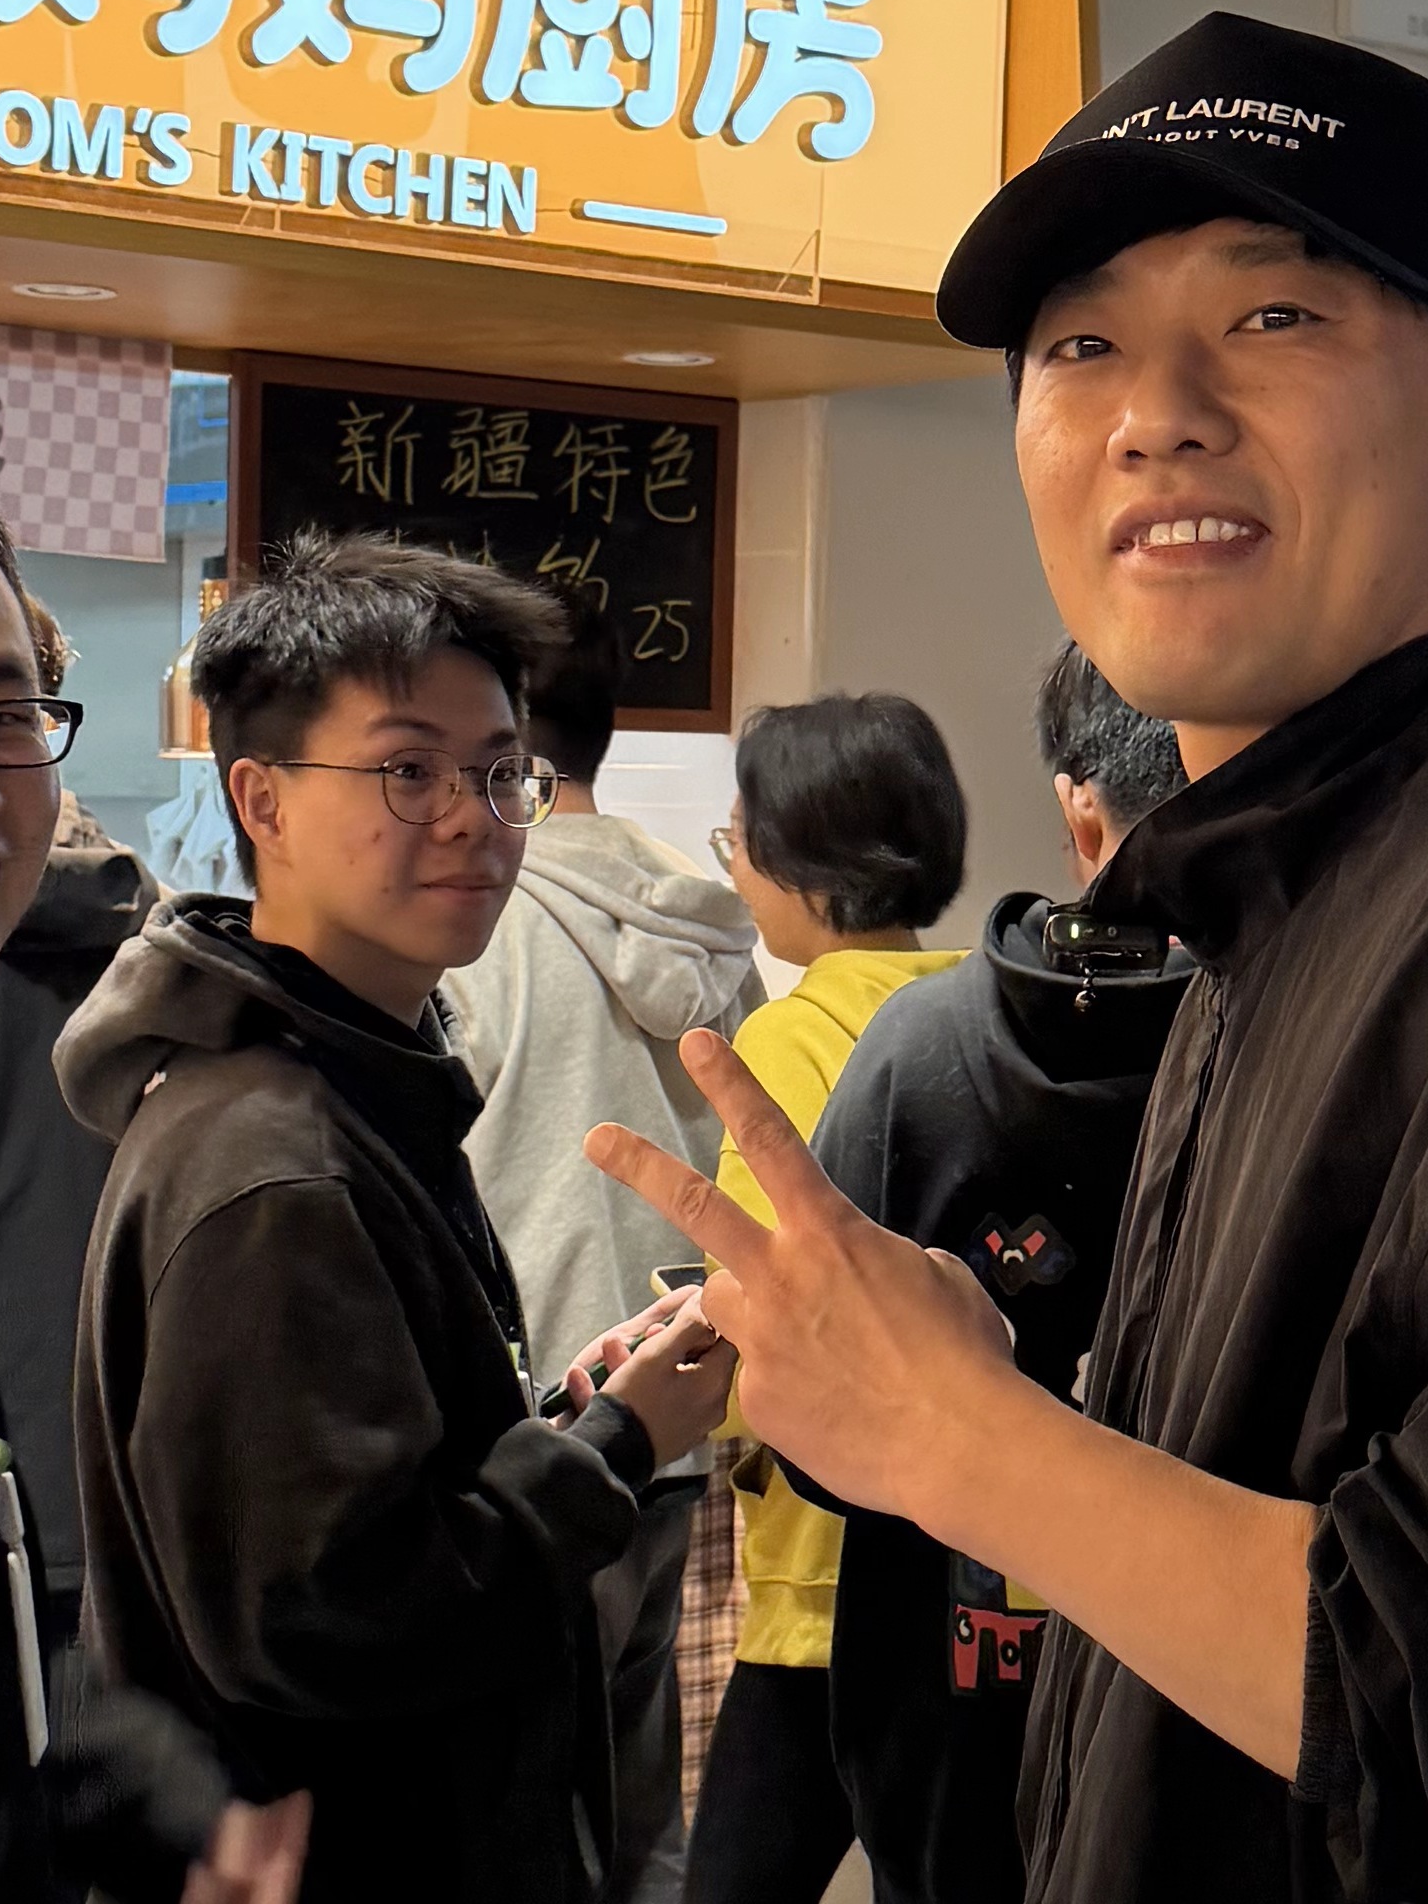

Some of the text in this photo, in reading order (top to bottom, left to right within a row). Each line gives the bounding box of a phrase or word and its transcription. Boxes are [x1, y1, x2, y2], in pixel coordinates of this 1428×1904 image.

[1166, 98, 1346, 138] LAURENT
[1229, 128, 1300, 149] YVES
[232, 123, 538, 235] KITCHEN
[336, 400, 699, 524] 新疆特色
[632, 599, 694, 663] 25
